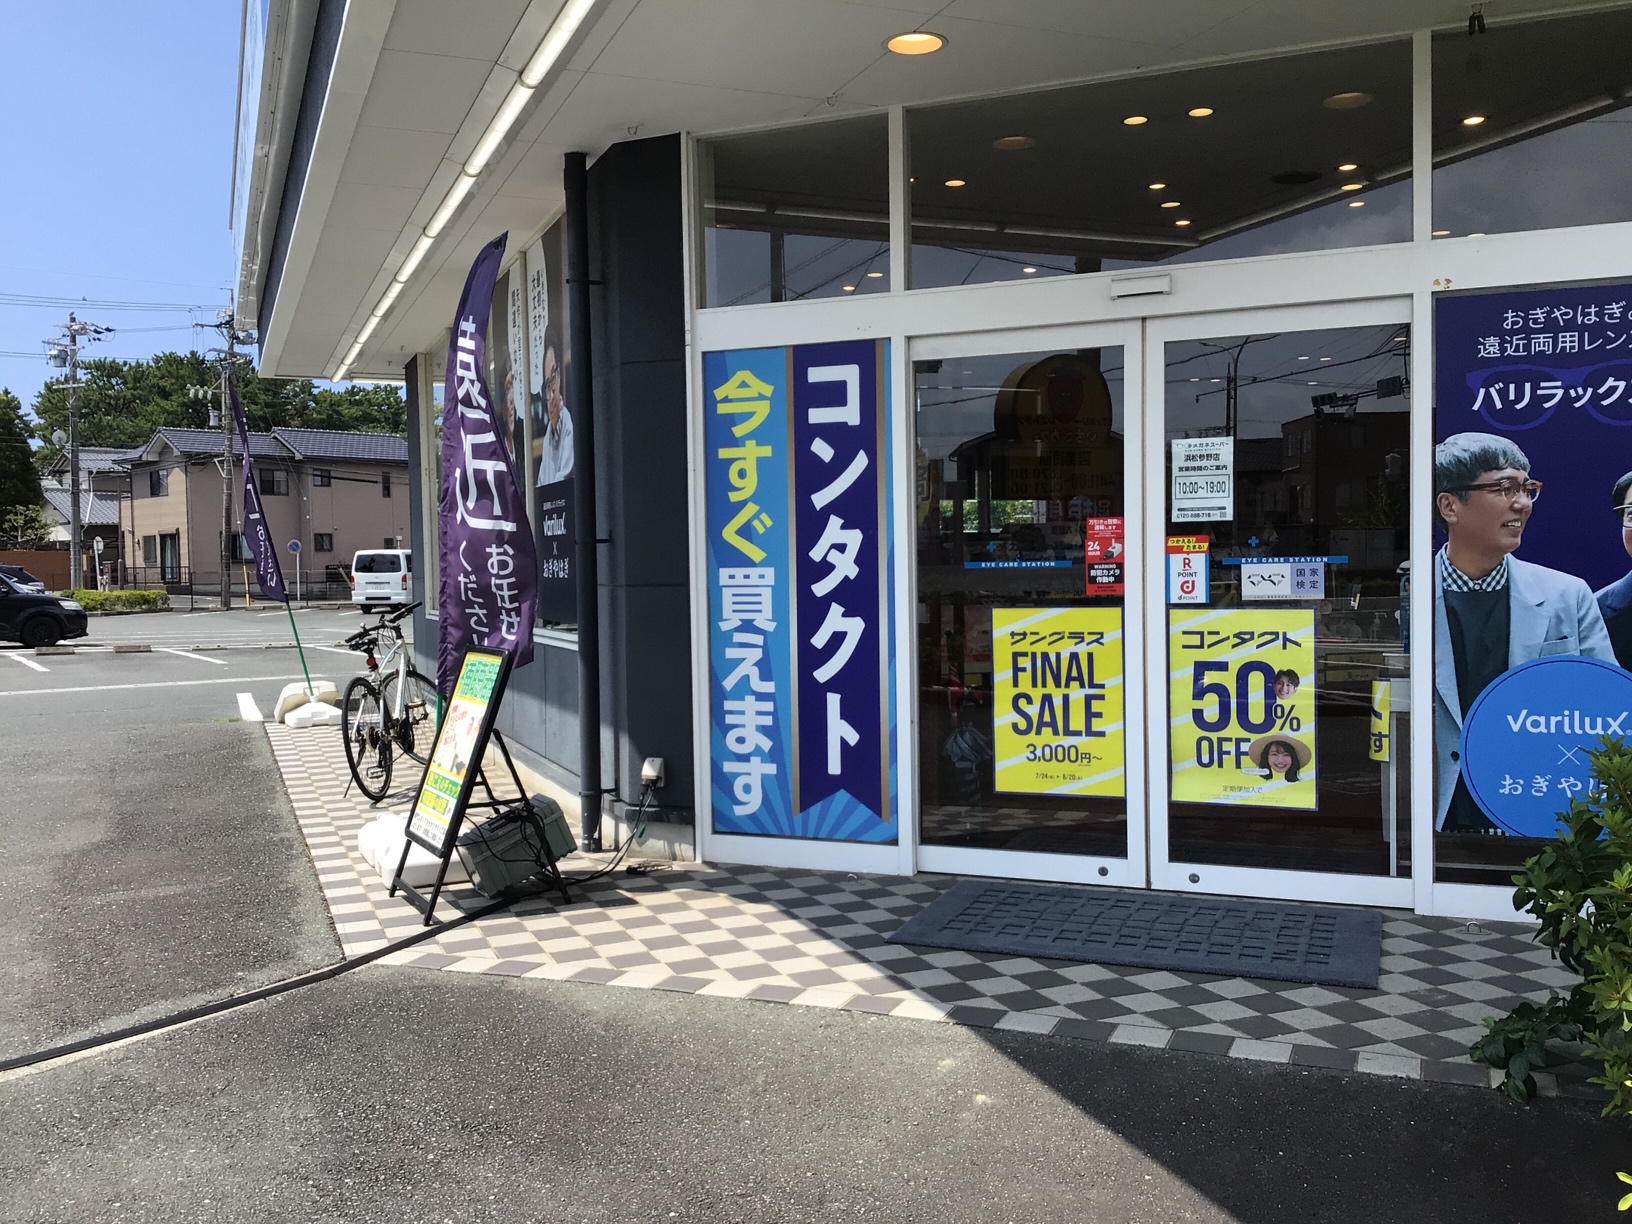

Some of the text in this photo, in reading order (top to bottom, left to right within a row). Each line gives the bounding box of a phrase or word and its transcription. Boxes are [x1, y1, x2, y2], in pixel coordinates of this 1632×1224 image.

[1178, 464, 1228, 472] 営業時間のご案内
[1088, 541, 1100, 550] 24
[543, 557, 570, 578] おぎやはぎ
[807, 363, 869, 776] コンタクト
[1296, 568, 1319, 577] 国家
[485, 543, 522, 641] お任せ
[712, 369, 777, 816] 今すぐ買えます
[1296, 580, 1319, 589] 検定
[1010, 630, 1104, 646] サングラス
[1182, 631, 1302, 650] コンタクト
[1011, 652, 1106, 689] FINAL
[1011, 692, 1106, 738] SALE
[1196, 736, 1252, 769] OFF
